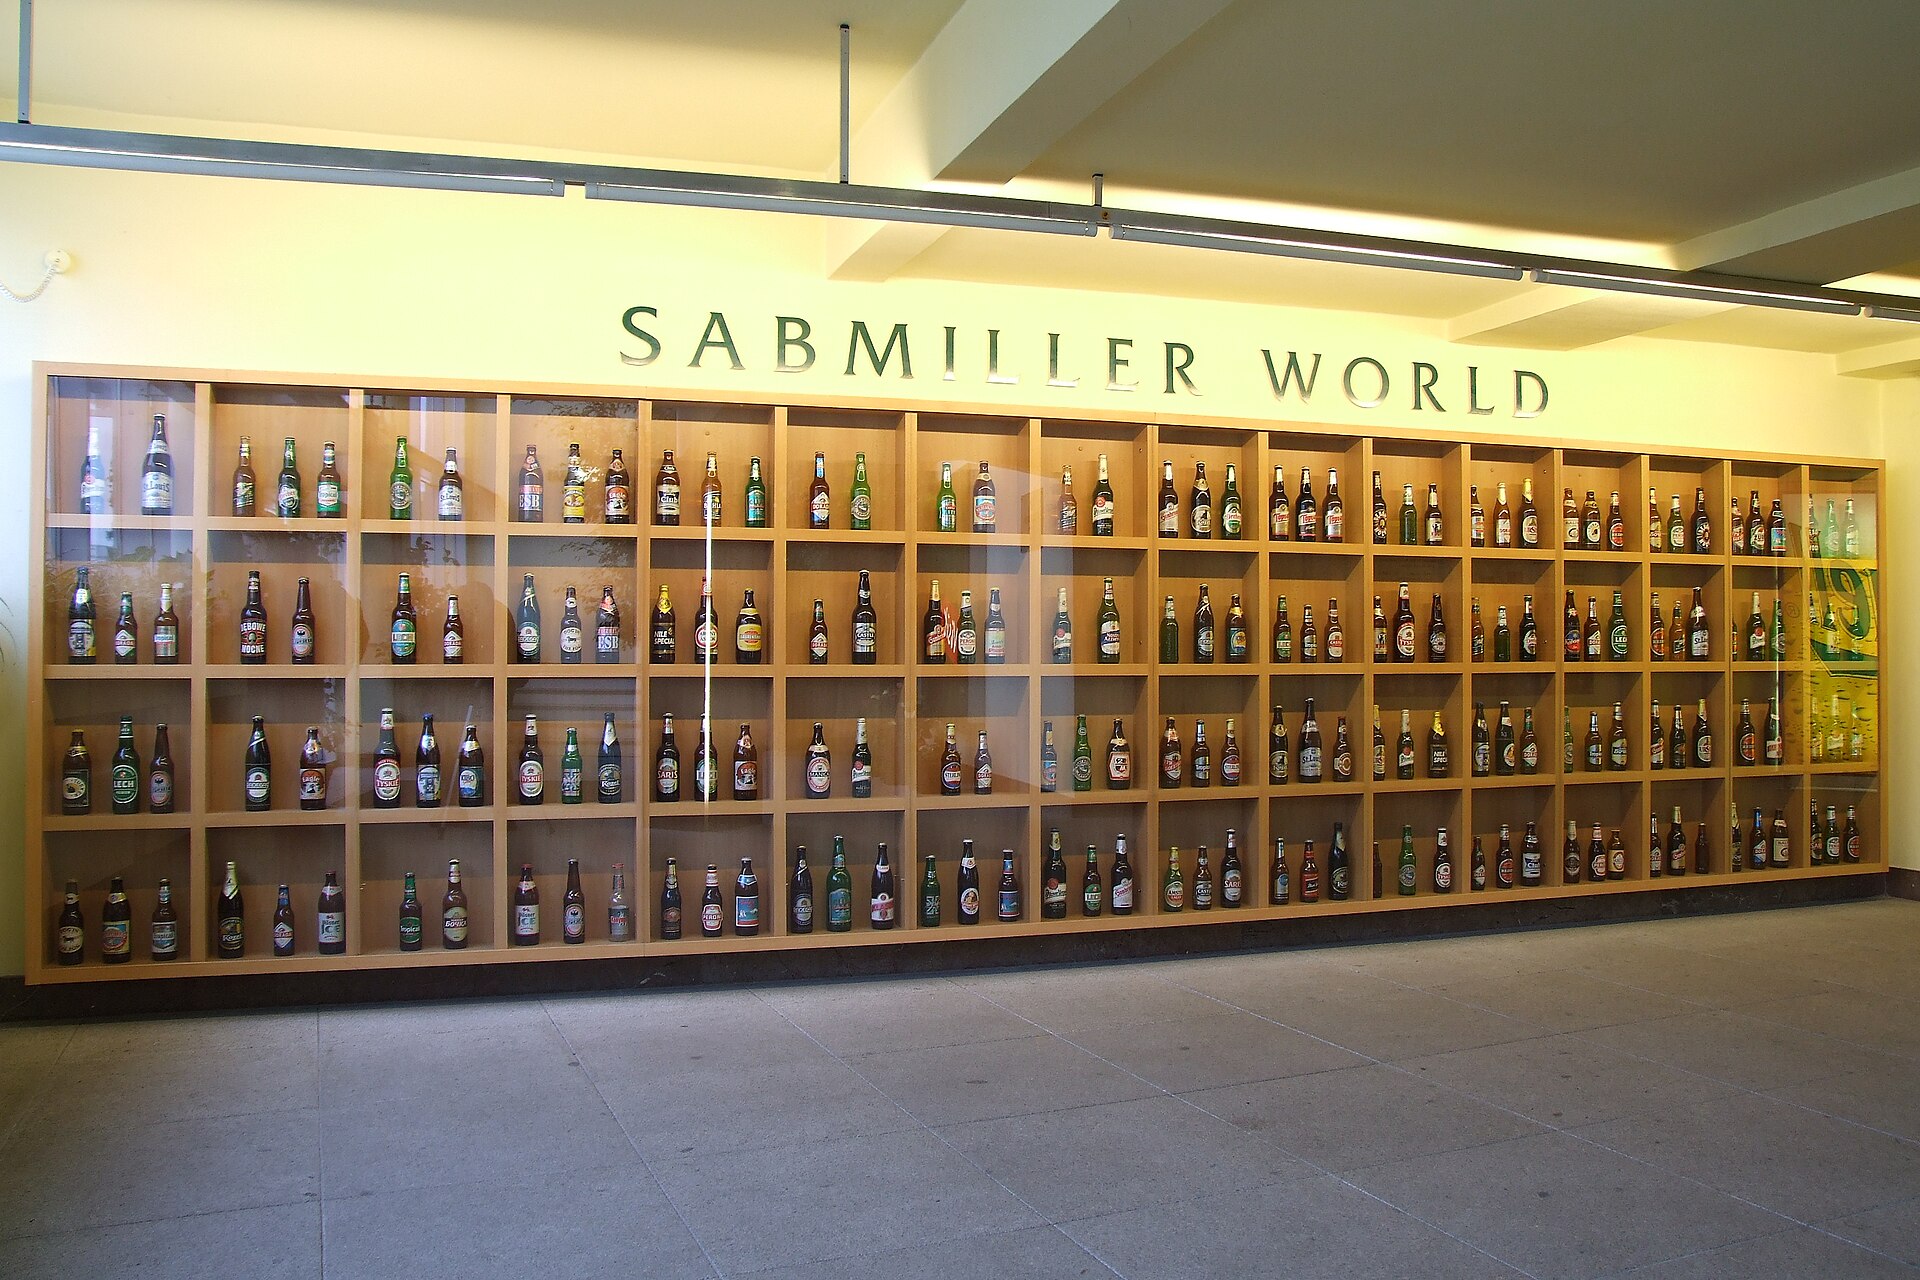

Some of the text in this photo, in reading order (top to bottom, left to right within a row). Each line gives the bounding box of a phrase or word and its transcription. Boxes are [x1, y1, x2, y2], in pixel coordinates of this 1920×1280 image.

[618, 305, 1551, 419] SABMILLER WORLD
[597, 636, 619, 649] ESB
[113, 780, 134, 788] LECH
[376, 779, 400, 788] TYSKIE
